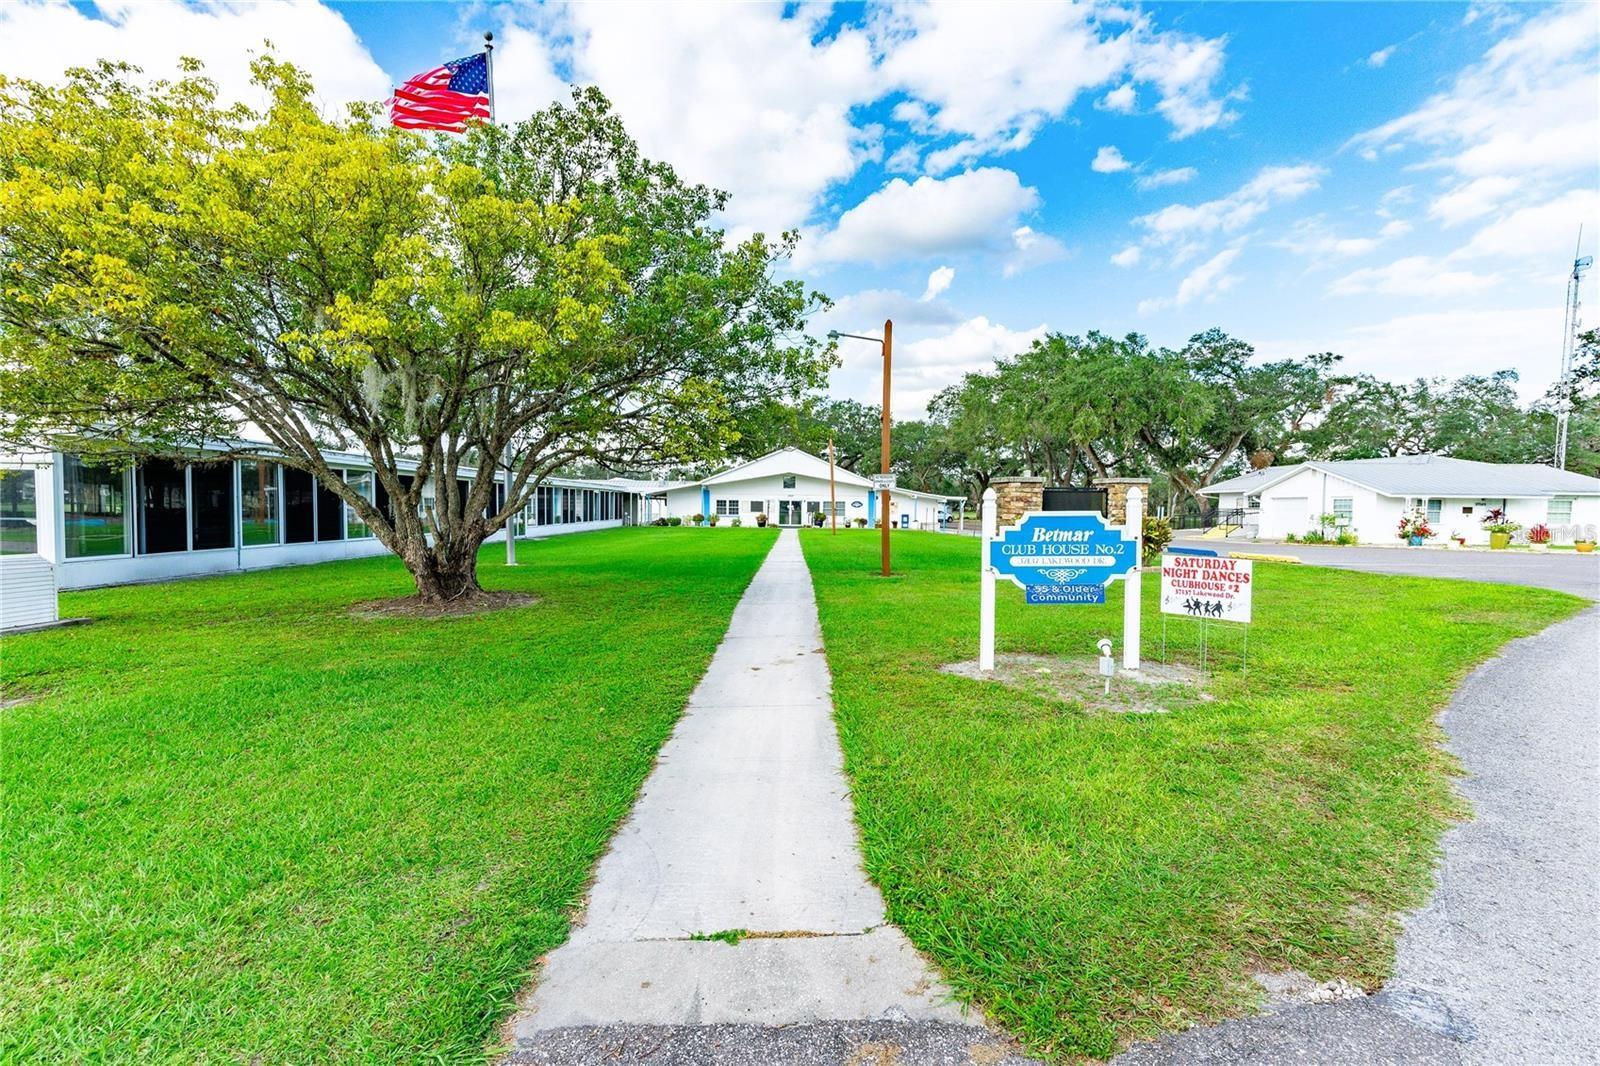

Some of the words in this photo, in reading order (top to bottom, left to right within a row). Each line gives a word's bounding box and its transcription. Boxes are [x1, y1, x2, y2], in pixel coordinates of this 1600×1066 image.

[1032, 527, 1095, 543] Betmar
[1001, 544, 1036, 555] CLUB
[1042, 544, 1090, 555] HOUSE
[1096, 544, 1125, 555] No.2
[1042, 557, 1090, 565] LAKEWOOD
[1174, 557, 1237, 571] SATURDAY
[1163, 567, 1198, 579] NIGHT
[1202, 570, 1250, 584] DANCES
[1051, 585, 1060, 593] &
[1062, 585, 1094, 593] Older
[1171, 579, 1226, 592] CLUBHOUSE
[1031, 593, 1099, 603] Community
[1193, 589, 1224, 599] Lakewood
